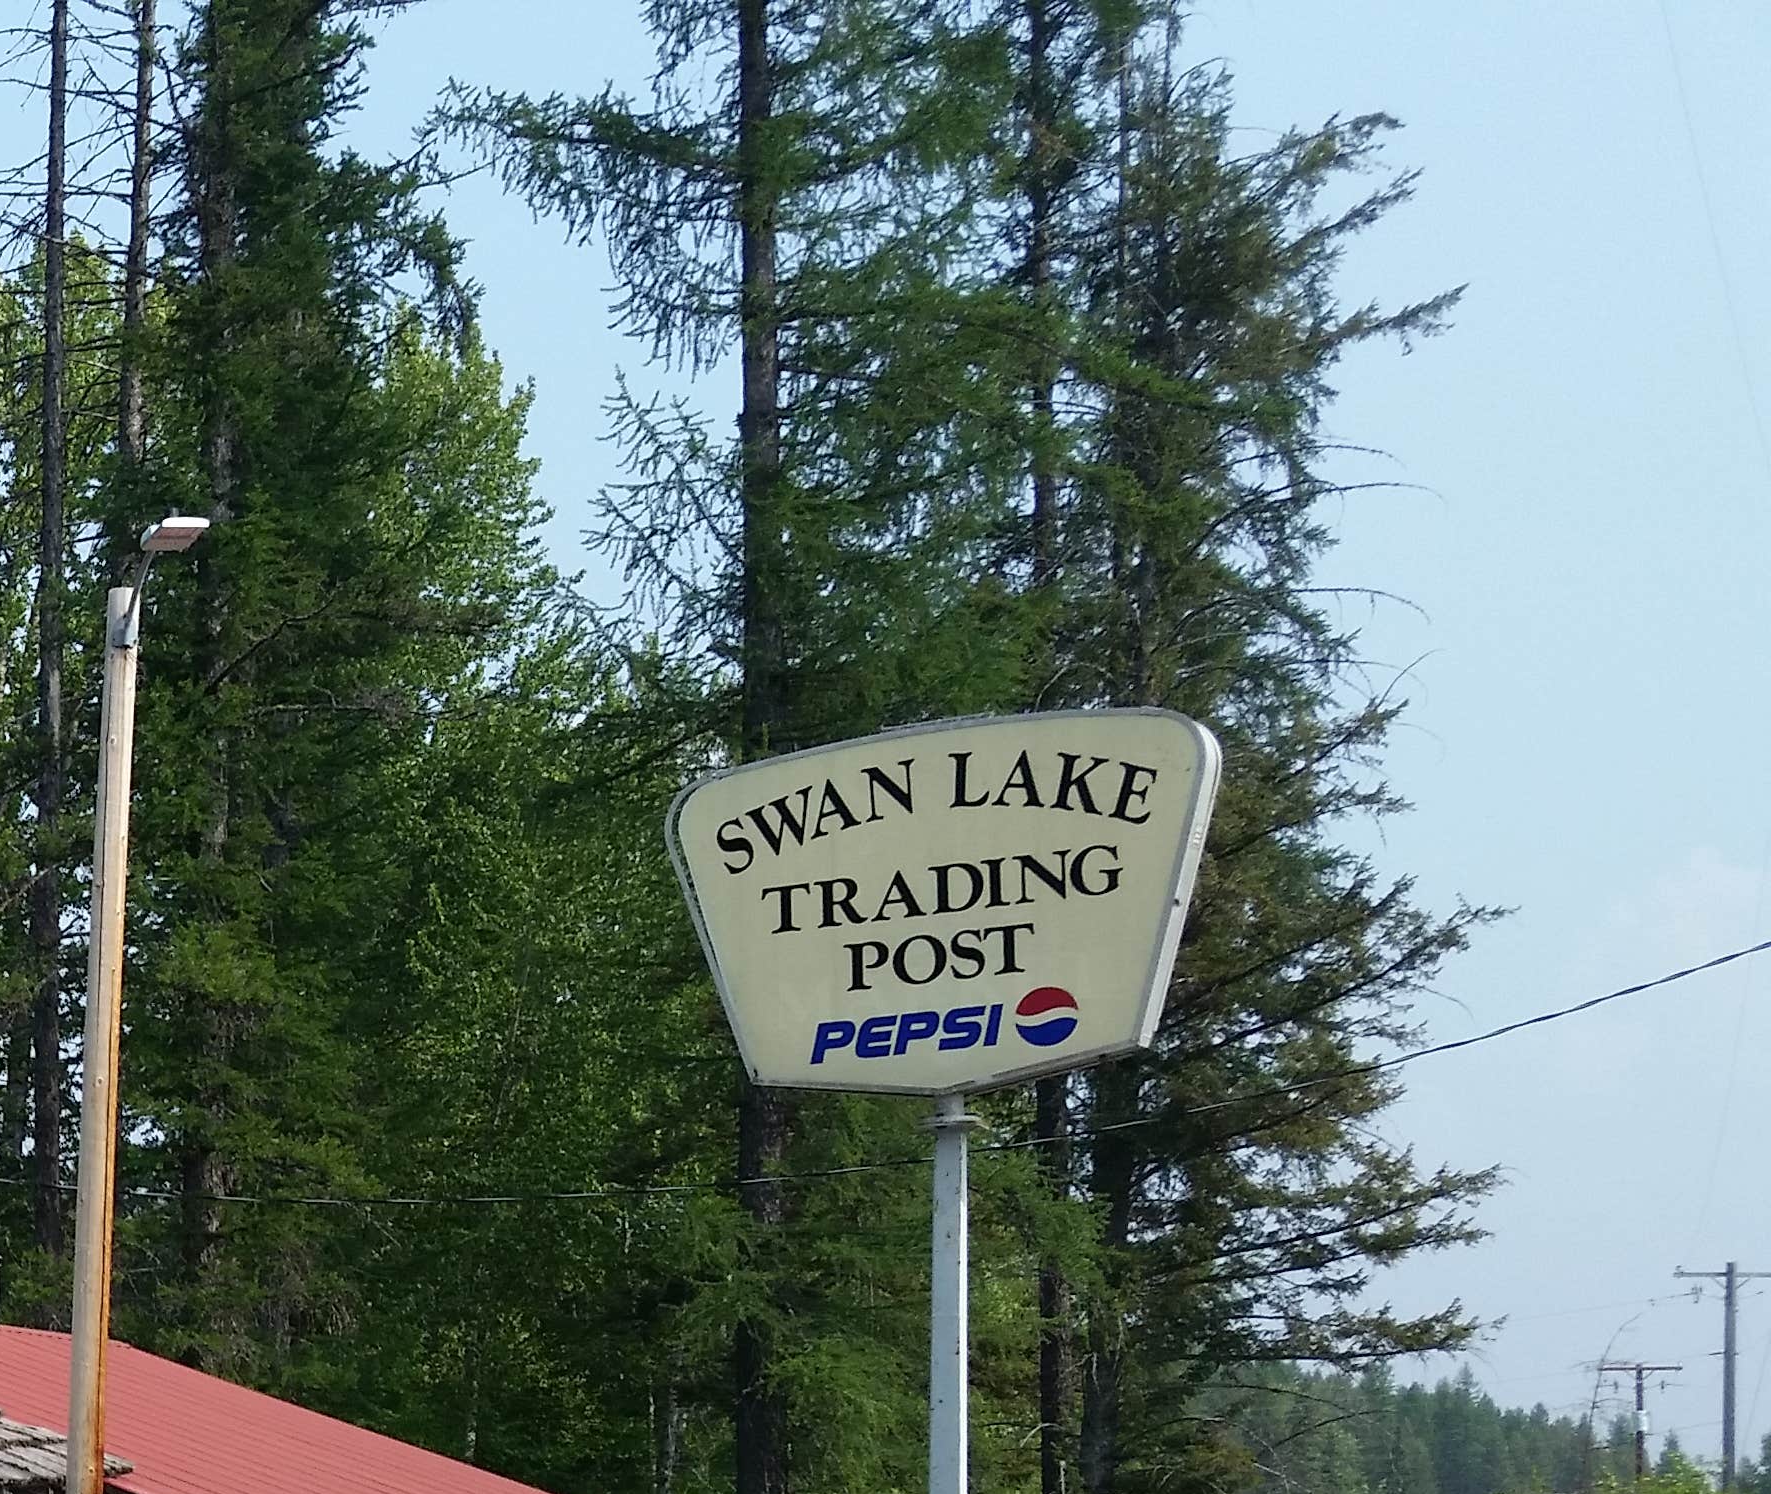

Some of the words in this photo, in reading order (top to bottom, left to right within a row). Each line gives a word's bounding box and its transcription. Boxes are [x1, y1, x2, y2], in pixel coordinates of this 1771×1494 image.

[715, 758, 916, 875] SWAN
[947, 749, 1158, 825] LAKE
[761, 845, 1124, 934] TRADING
[843, 922, 1036, 992] POST
[809, 1003, 1004, 1064] PEPSI
